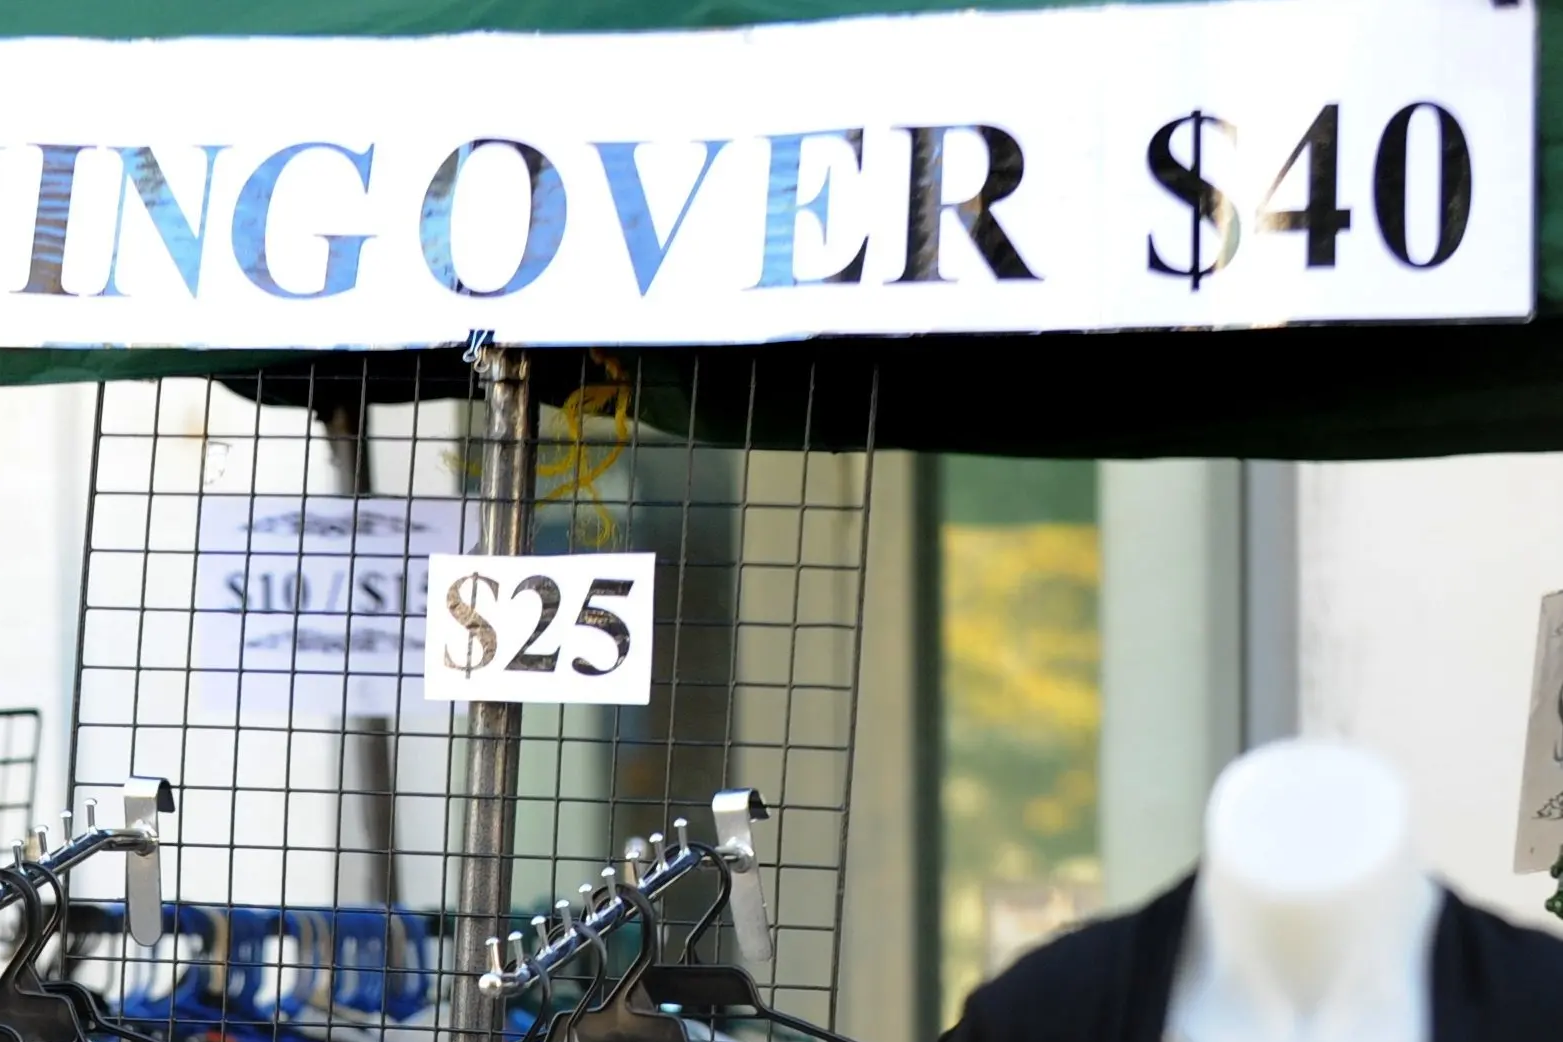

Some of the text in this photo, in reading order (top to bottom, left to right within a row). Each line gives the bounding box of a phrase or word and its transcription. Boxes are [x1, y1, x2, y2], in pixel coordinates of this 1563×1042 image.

[417, 121, 1045, 300] OVER
[1145, 99, 1474, 292] $40
[442, 571, 636, 680] $25
